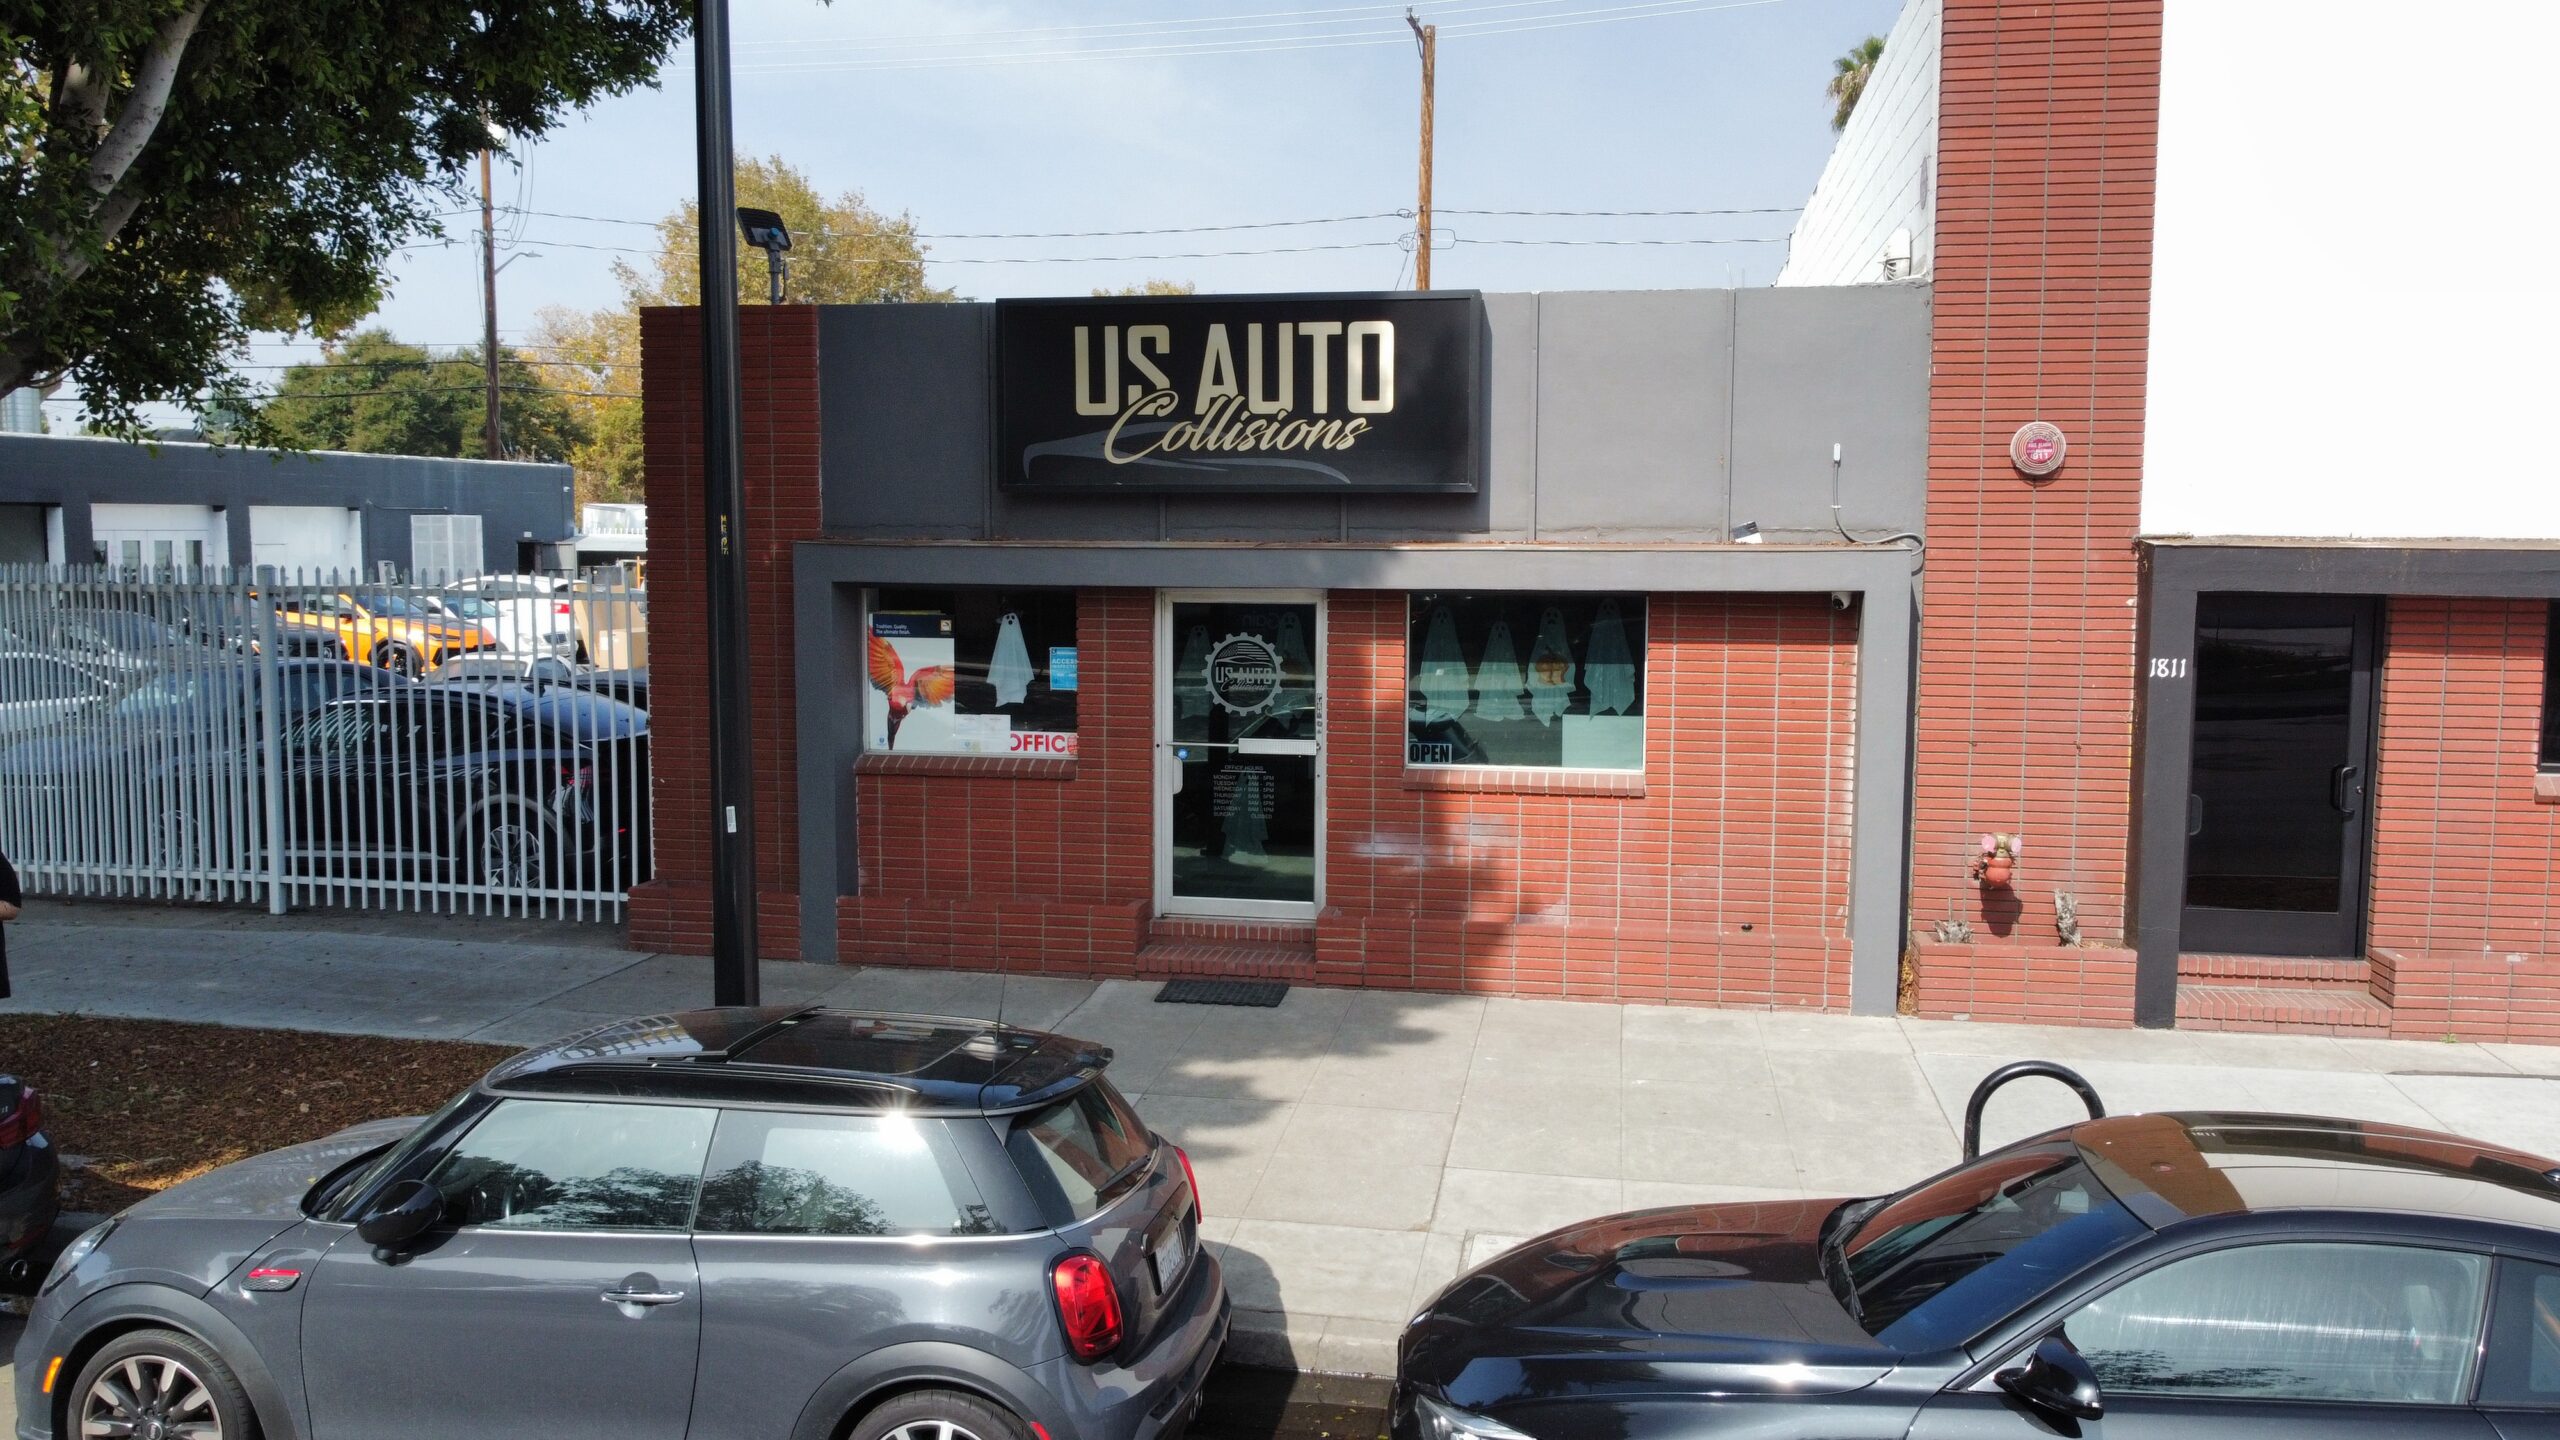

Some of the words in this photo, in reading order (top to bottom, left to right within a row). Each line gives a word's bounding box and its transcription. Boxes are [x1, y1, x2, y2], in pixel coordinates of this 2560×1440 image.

[1074, 324, 1170, 416] US
[1195, 319, 1395, 415] AUTO
[1103, 390, 1373, 465] Collisions
[1215, 666, 1233, 683] US
[1237, 667, 1272, 685] AUTO
[2149, 657, 2187, 678] 1811
[1010, 733, 1078, 754] OFFIC
[1409, 743, 1450, 763] OPEN
